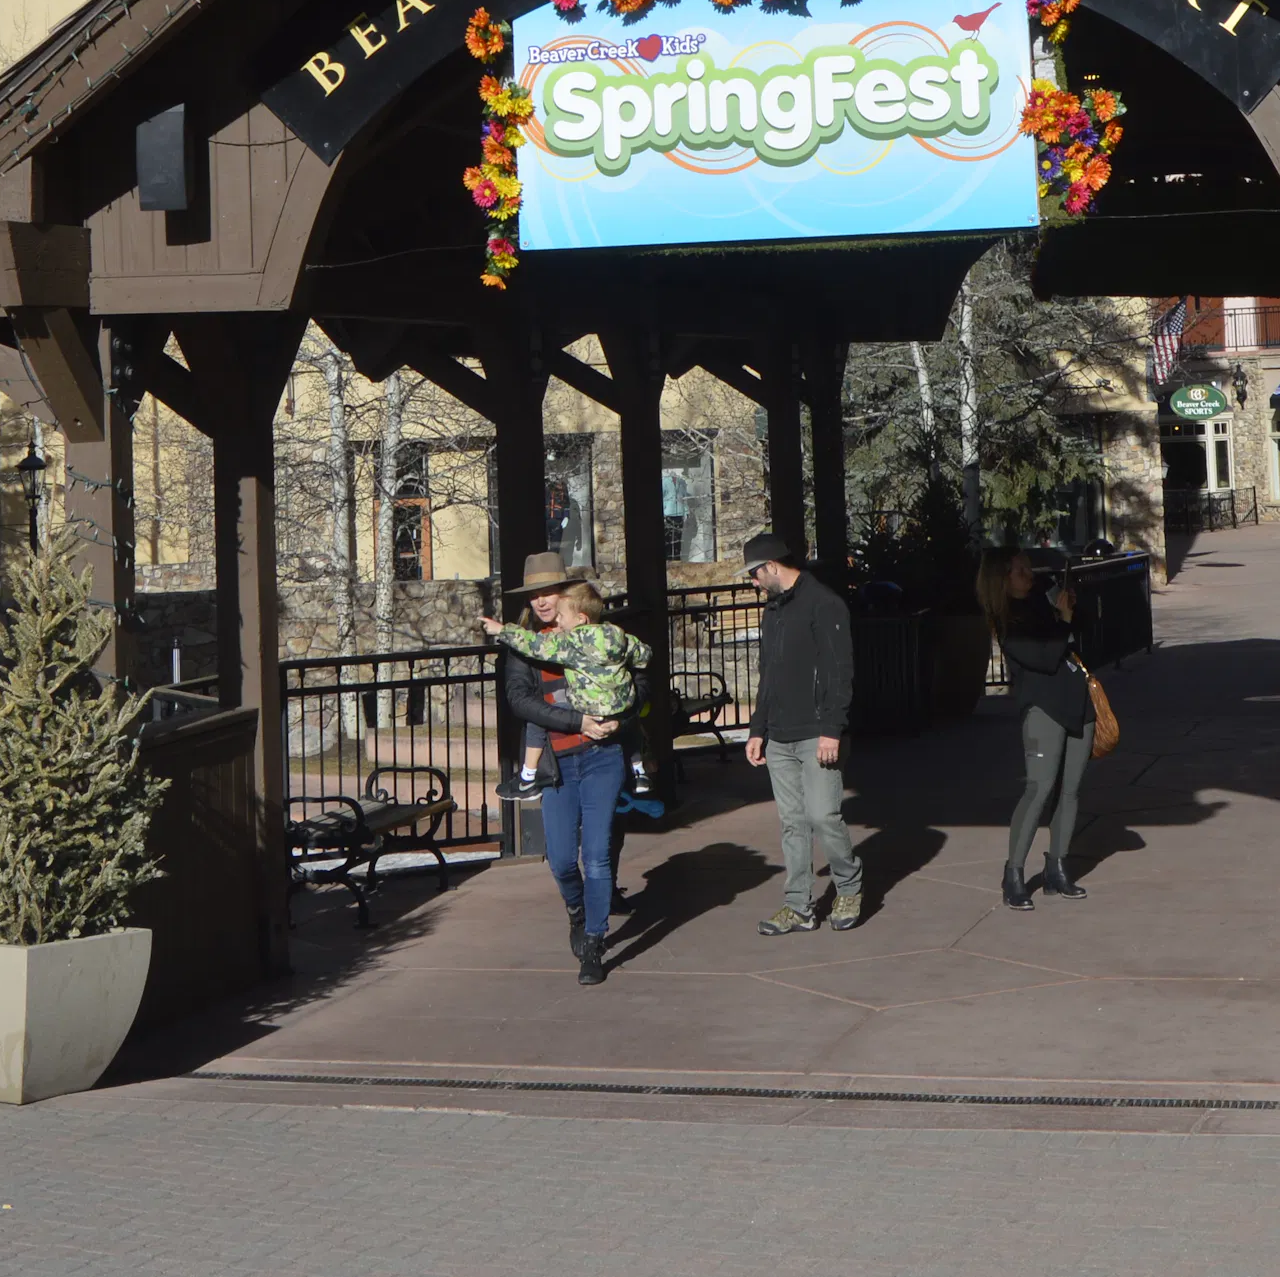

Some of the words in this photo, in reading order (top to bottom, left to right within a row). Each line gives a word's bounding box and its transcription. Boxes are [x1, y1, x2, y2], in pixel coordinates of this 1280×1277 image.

[528, 46, 586, 64] Beaver
[587, 39, 640, 60] Creek
[552, 49, 989, 162] SpringFest
[1184, 407, 1213, 415] SPORTS
[1200, 400, 1220, 408] Creek
